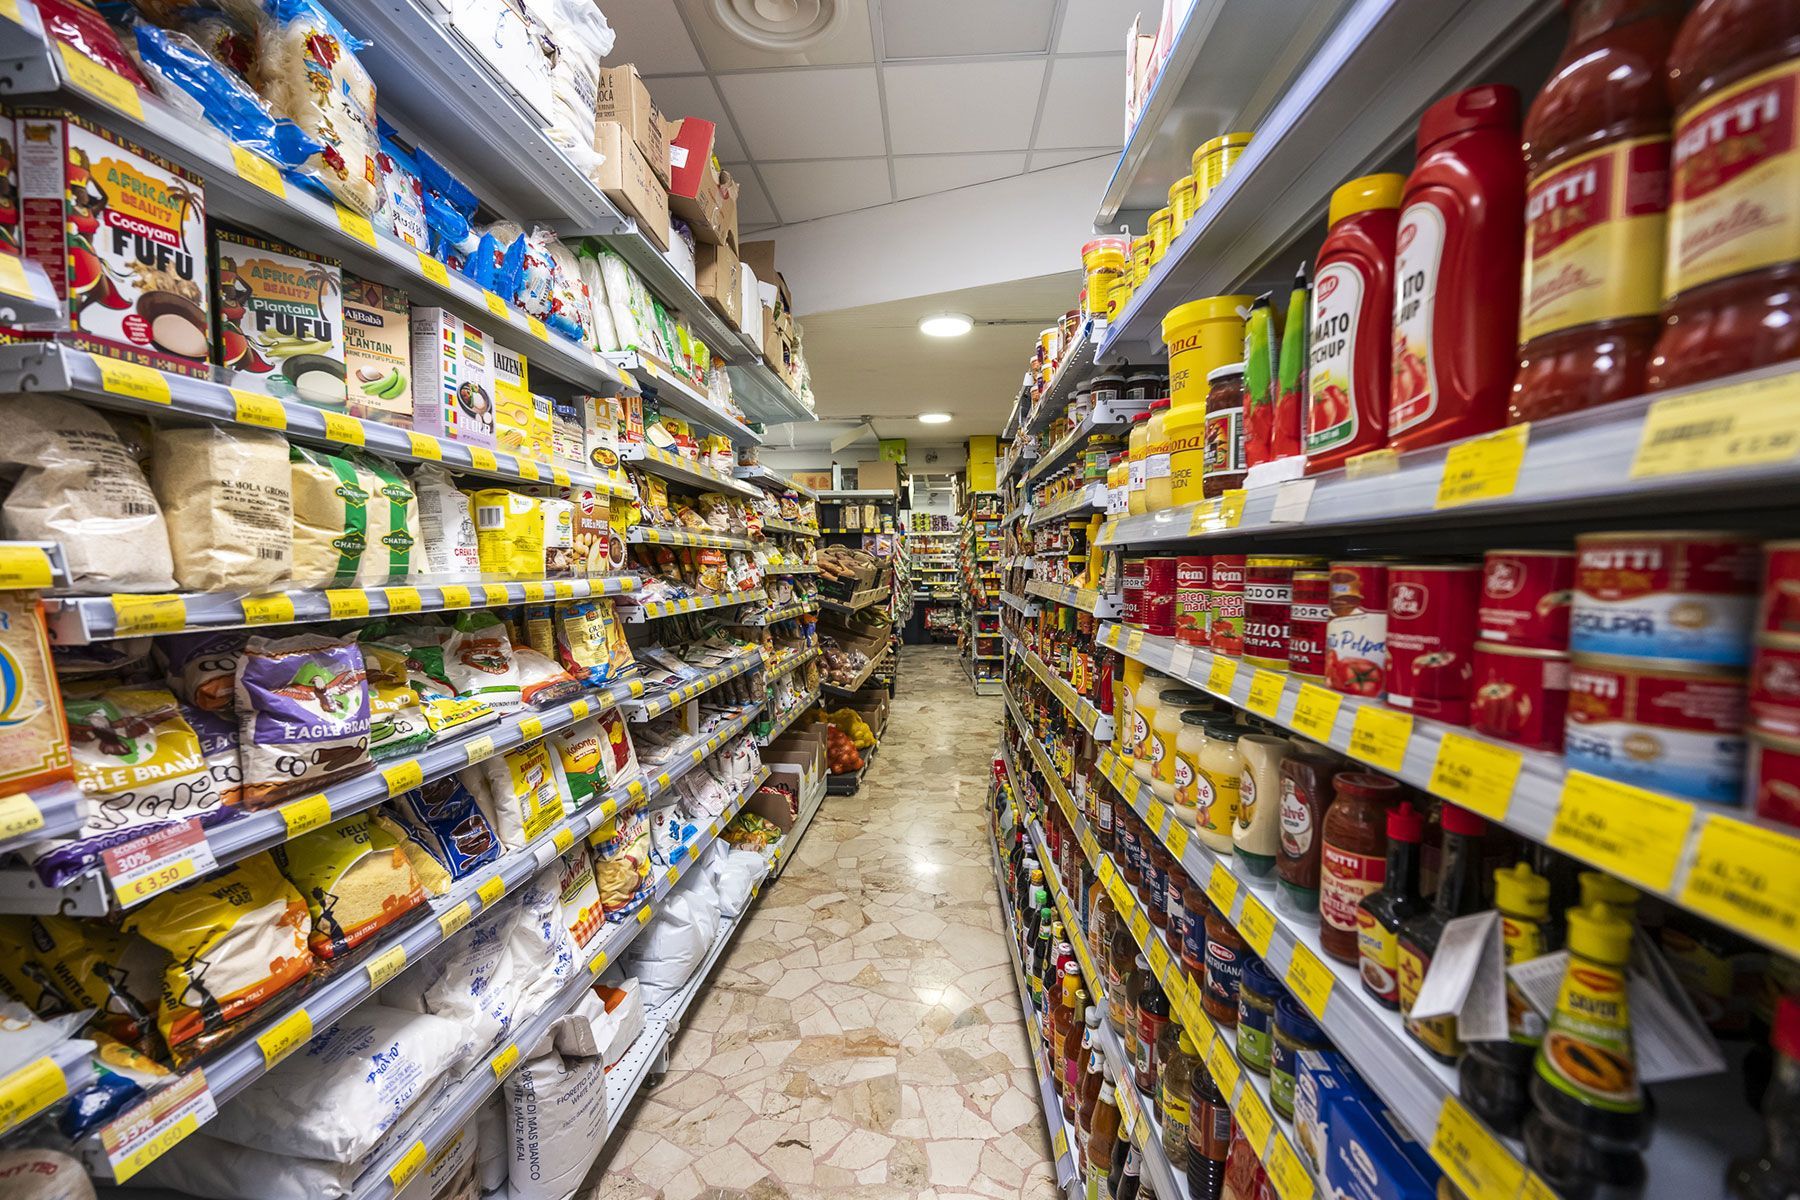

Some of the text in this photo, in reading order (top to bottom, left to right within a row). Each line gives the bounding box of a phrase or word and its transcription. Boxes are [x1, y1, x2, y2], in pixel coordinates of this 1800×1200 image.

[107, 167, 180, 213] AFRICAN
[121, 191, 172, 222] BEAUTY
[108, 211, 176, 243] Cocoyam
[112, 226, 193, 281] FUFU
[251, 265, 318, 290] AFRICAN
[263, 282, 310, 299] BEAUTY
[253, 299, 314, 316] Plantain
[256, 311, 332, 342] FUFU
[460, 416, 491, 437] FLOUR
[383, 536, 408, 545] CHATIR
[1340, 630, 1386, 656] Polpa
[284, 719, 371, 741] EAGLE BRAN
[136, 751, 205, 783] BRAND
[116, 849, 152, 873] 30%
[135, 866, 180, 895] € 3,50
[325, 934, 356, 952] PACKED
[362, 920, 379, 937] ITALY
[556, 1077, 588, 1106] FIORETTO
[526, 1103, 537, 1115] DI
[527, 1115, 538, 1141] MAIS
[515, 1136, 526, 1161] MEAL
[528, 1141, 541, 1181] BIANCO
